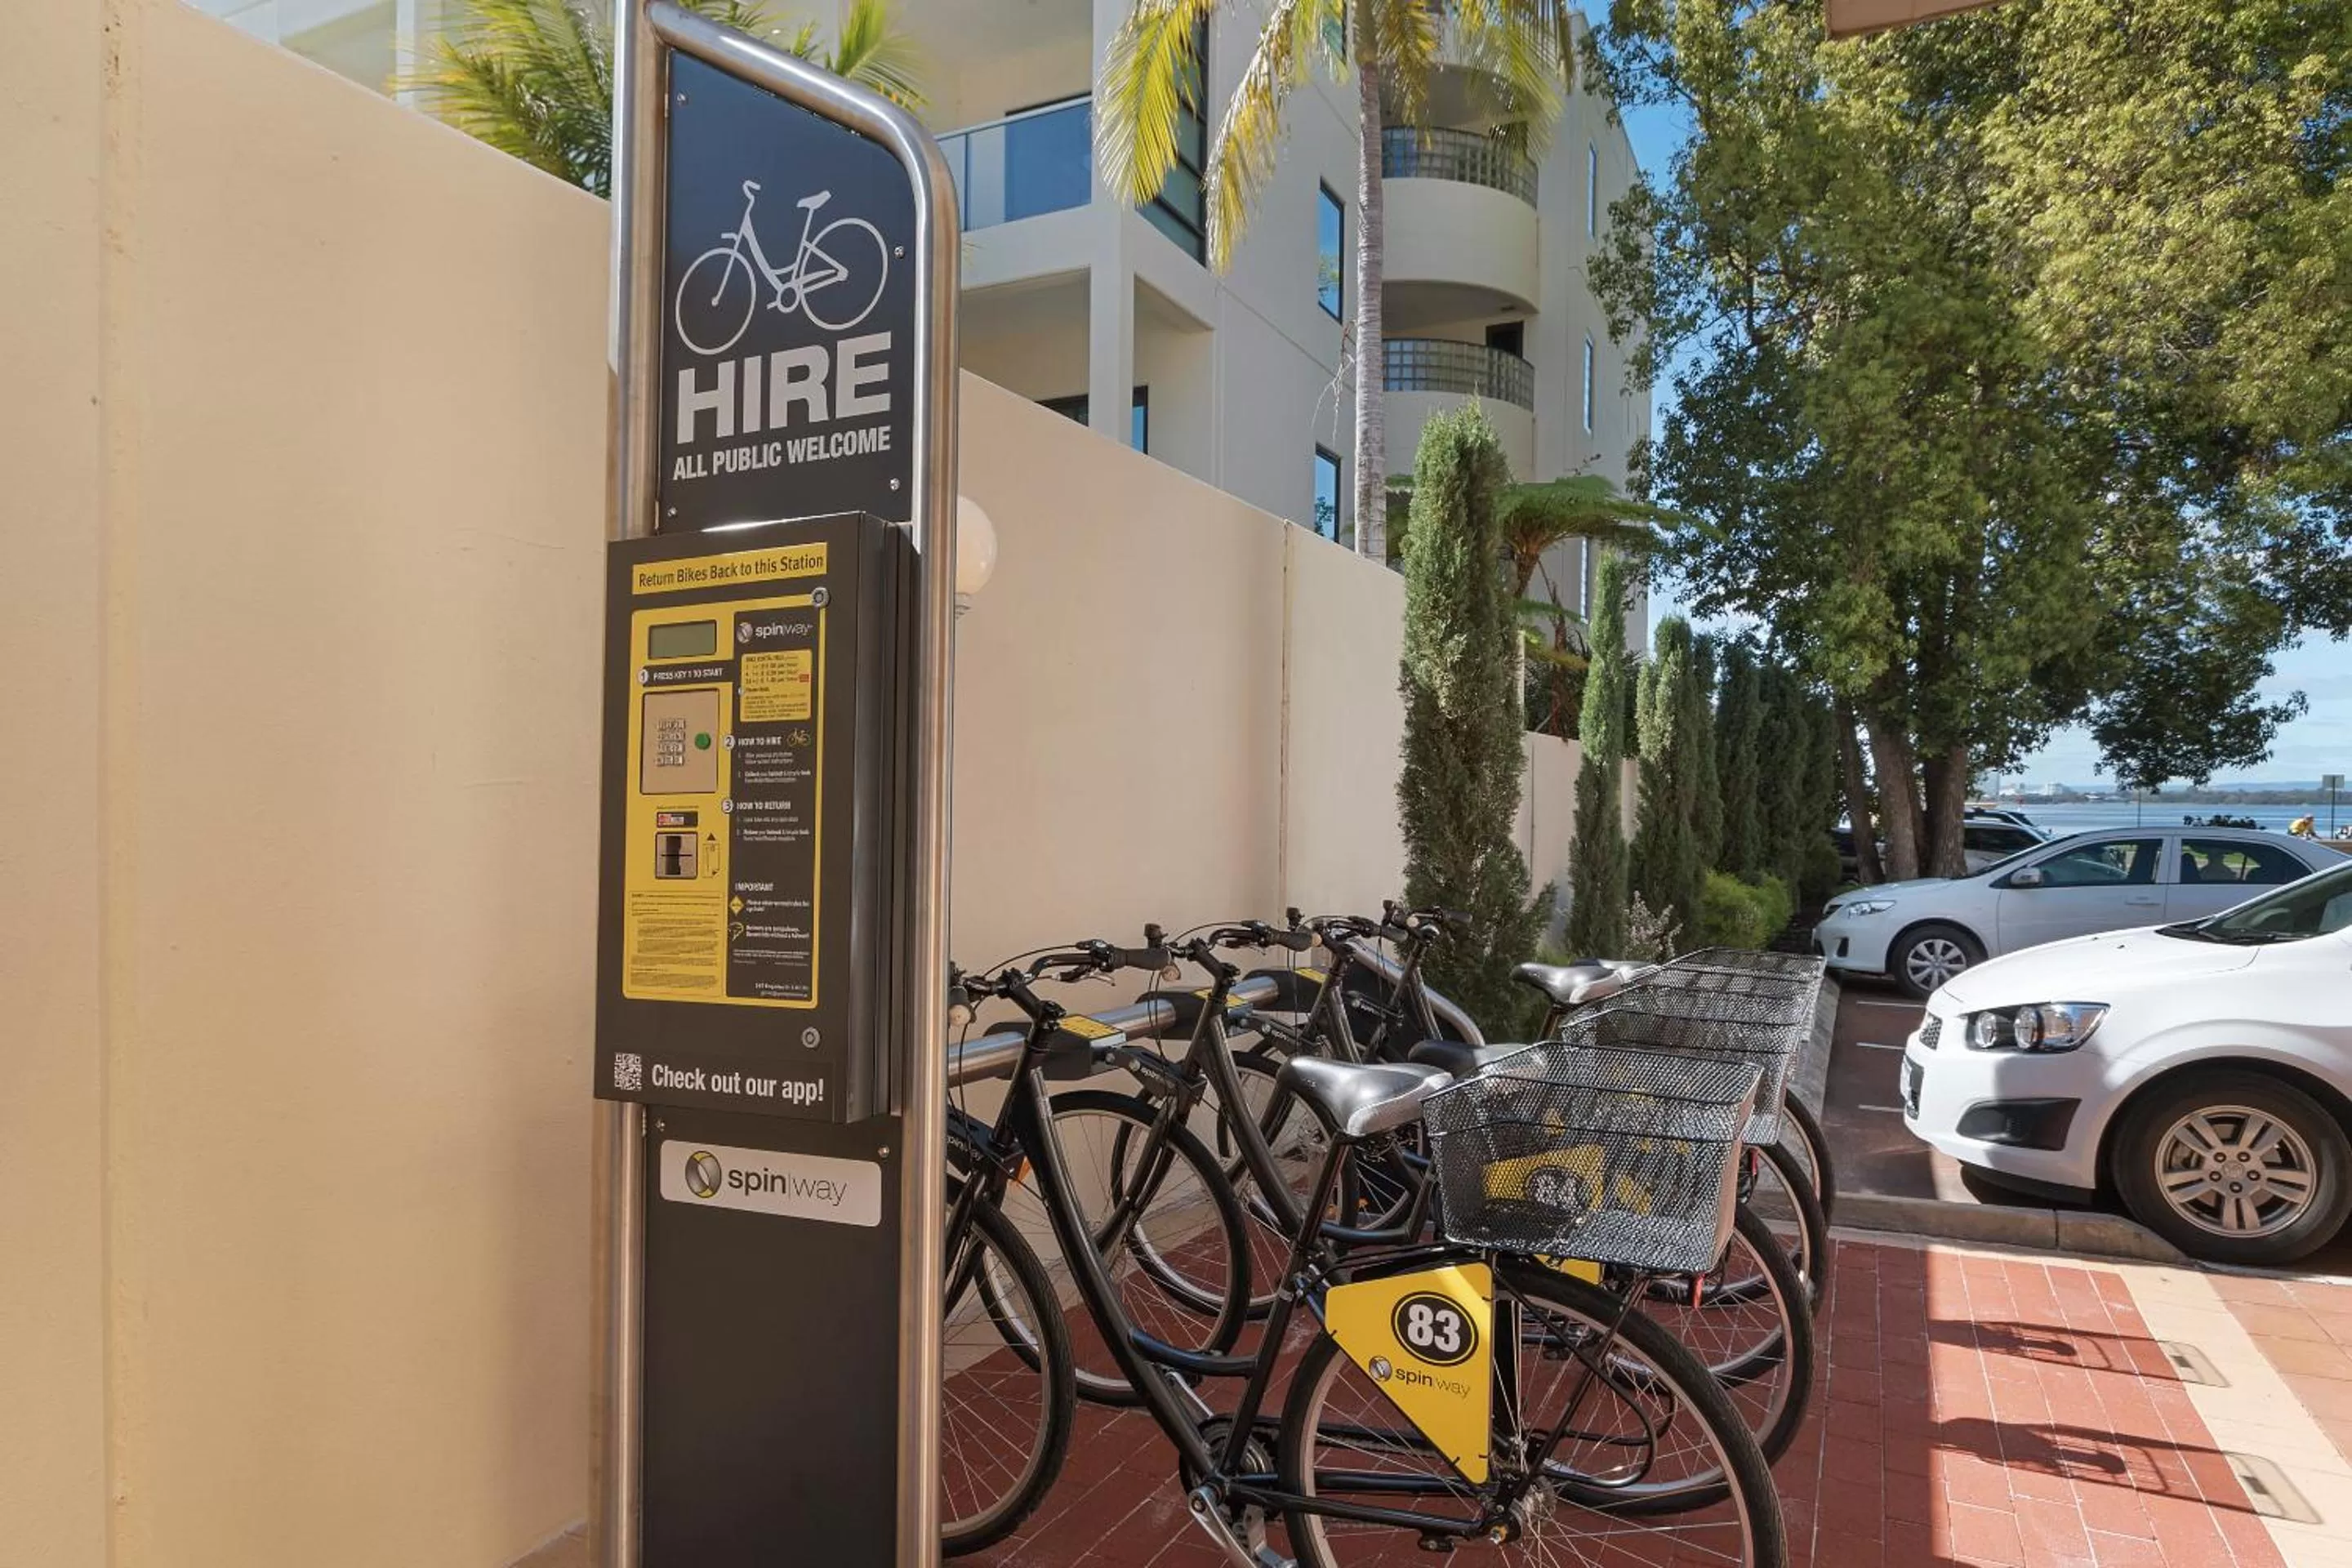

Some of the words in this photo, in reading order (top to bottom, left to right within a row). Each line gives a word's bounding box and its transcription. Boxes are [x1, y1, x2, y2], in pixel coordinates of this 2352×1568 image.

[675, 331, 893, 445] HIRE
[672, 454, 708, 481] ALL
[712, 441, 782, 474] PUBLIC
[786, 425, 892, 466] WELCOME
[639, 572, 675, 588] Return
[677, 568, 707, 583] Bikes
[710, 564, 737, 581] Back
[740, 563, 752, 577] to
[755, 559, 777, 575] this
[780, 554, 824, 572] Station
[651, 1063, 706, 1091] Check
[710, 1071, 741, 1094] out
[745, 1078, 777, 1098] our
[782, 1078, 824, 1107] app!
[1406, 1303, 1462, 1353] 83
